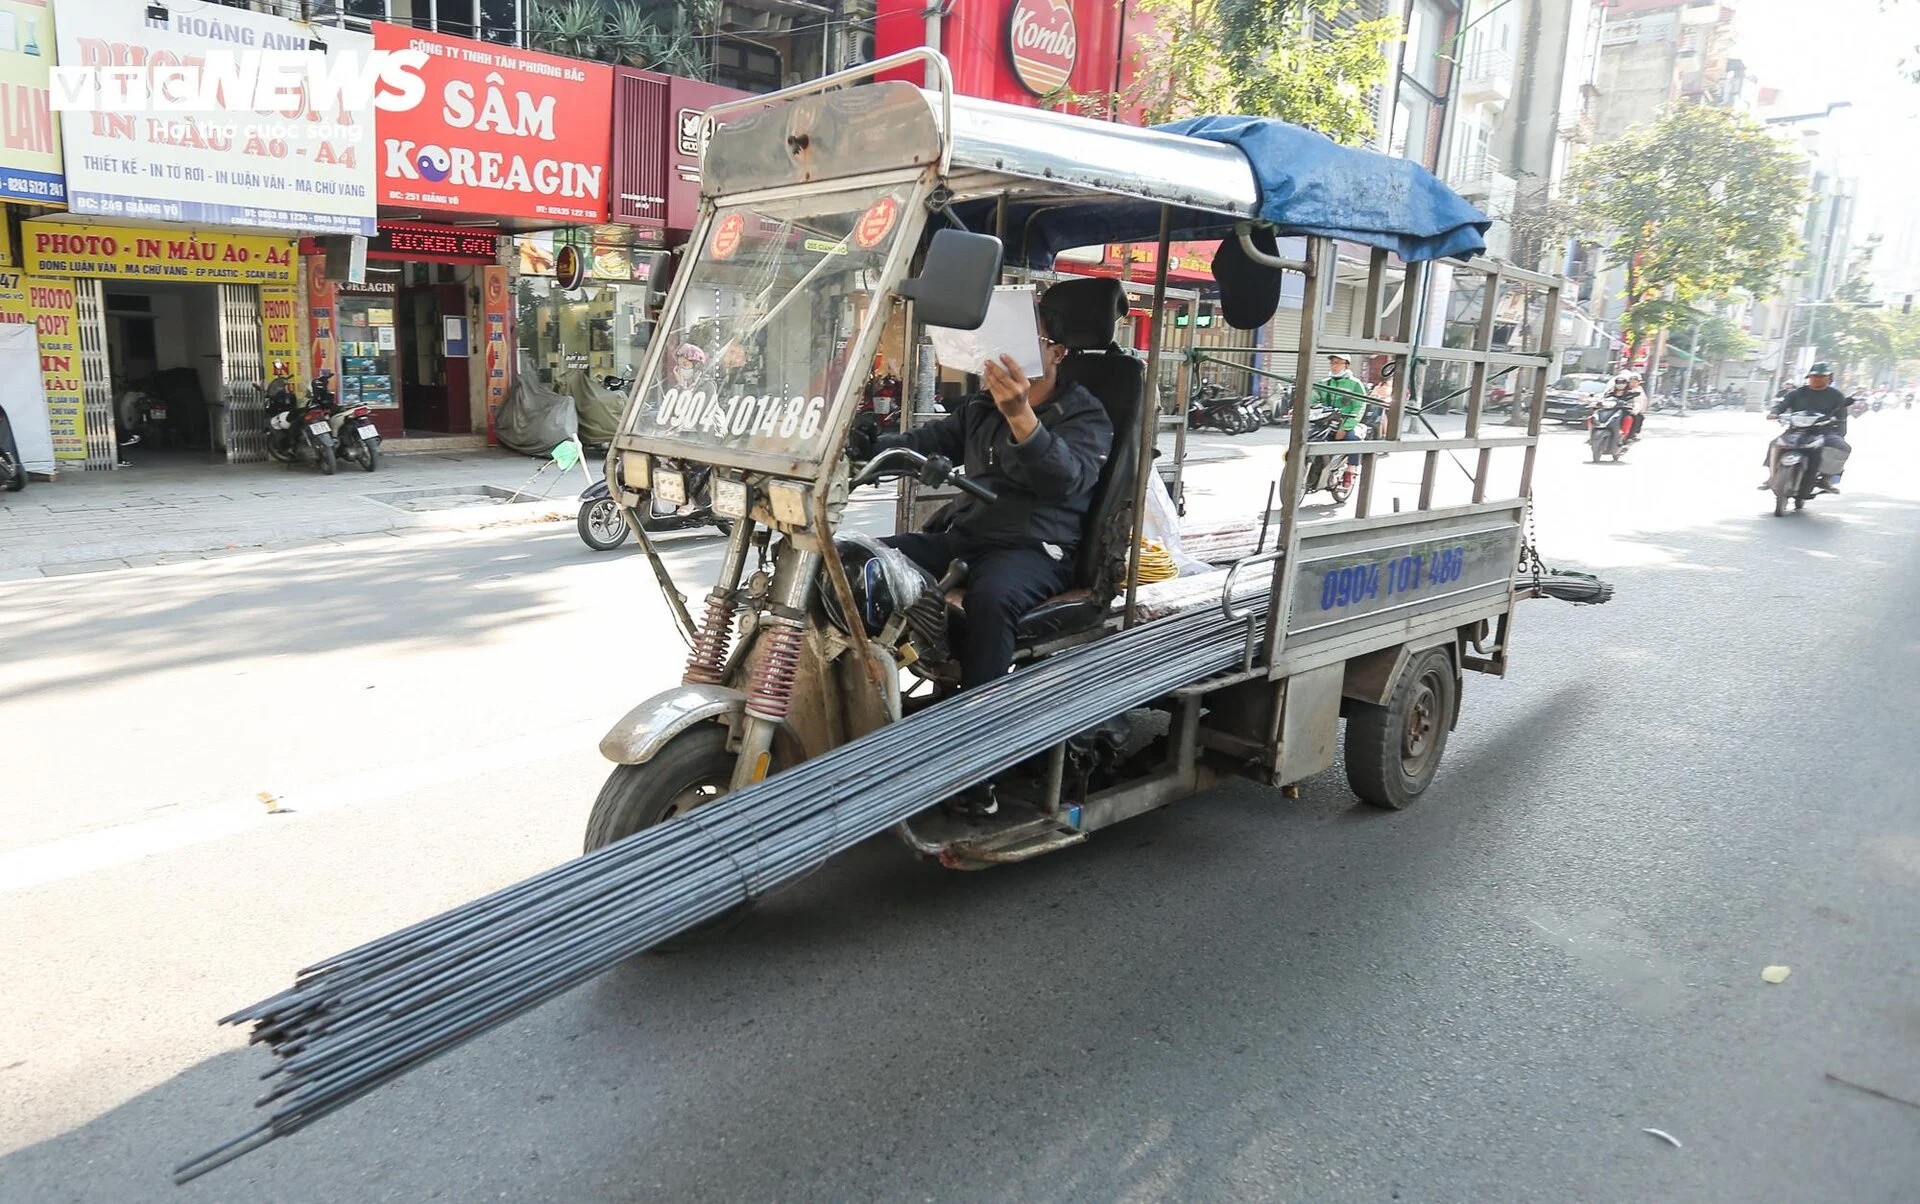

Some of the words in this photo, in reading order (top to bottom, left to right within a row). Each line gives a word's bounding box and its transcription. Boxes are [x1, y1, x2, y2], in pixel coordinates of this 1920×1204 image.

[445, 46, 460, 59] TY
[463, 49, 492, 65] TNHH
[494, 55, 516, 71] TÂN
[443, 71, 556, 141] SÂM
[90, 111, 136, 141] IN
[314, 140, 356, 169] A4
[150, 163, 163, 177] IN
[216, 171, 229, 184] IN
[36, 233, 117, 256] PHOTO
[136, 238, 161, 258] IN
[265, 246, 291, 266] A4
[30, 287, 73, 309] PHOTO
[264, 300, 291, 319] PHOTO
[37, 314, 70, 336] COPY
[268, 324, 289, 343] COPY
[1321, 562, 1380, 611] 0904
[1387, 554, 1424, 595] 101
[1429, 546, 1464, 586] 486
